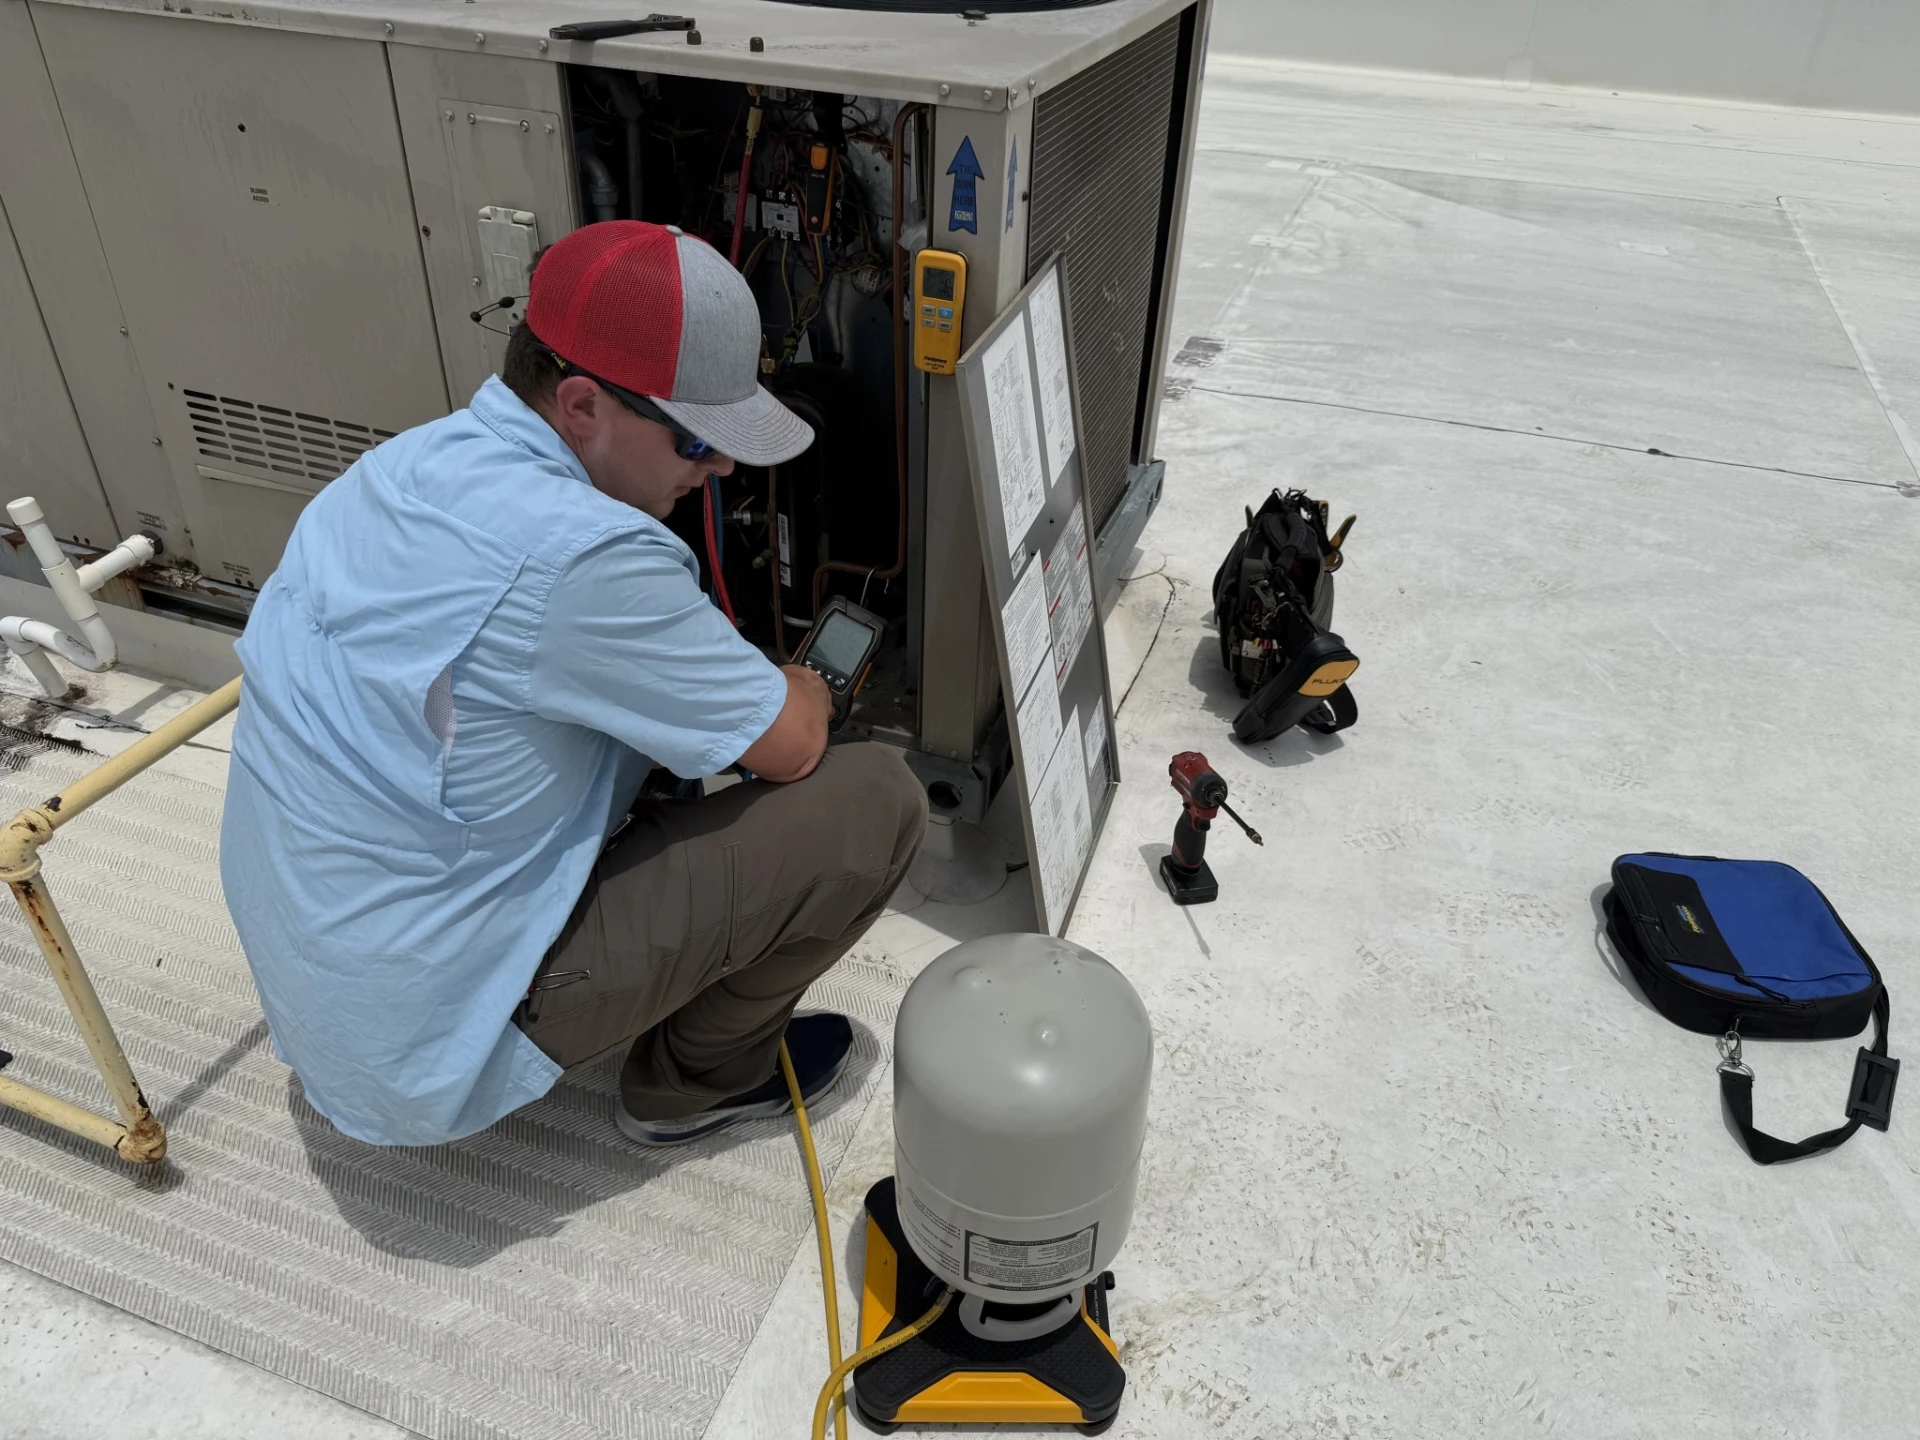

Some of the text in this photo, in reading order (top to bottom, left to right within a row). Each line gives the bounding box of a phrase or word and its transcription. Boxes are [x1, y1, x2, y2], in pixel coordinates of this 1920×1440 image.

[959, 164, 973, 175] TIE
[956, 180, 974, 191] DOWN
[955, 195, 975, 206] HERE
[923, 355, 948, 364] Fieldpiece
